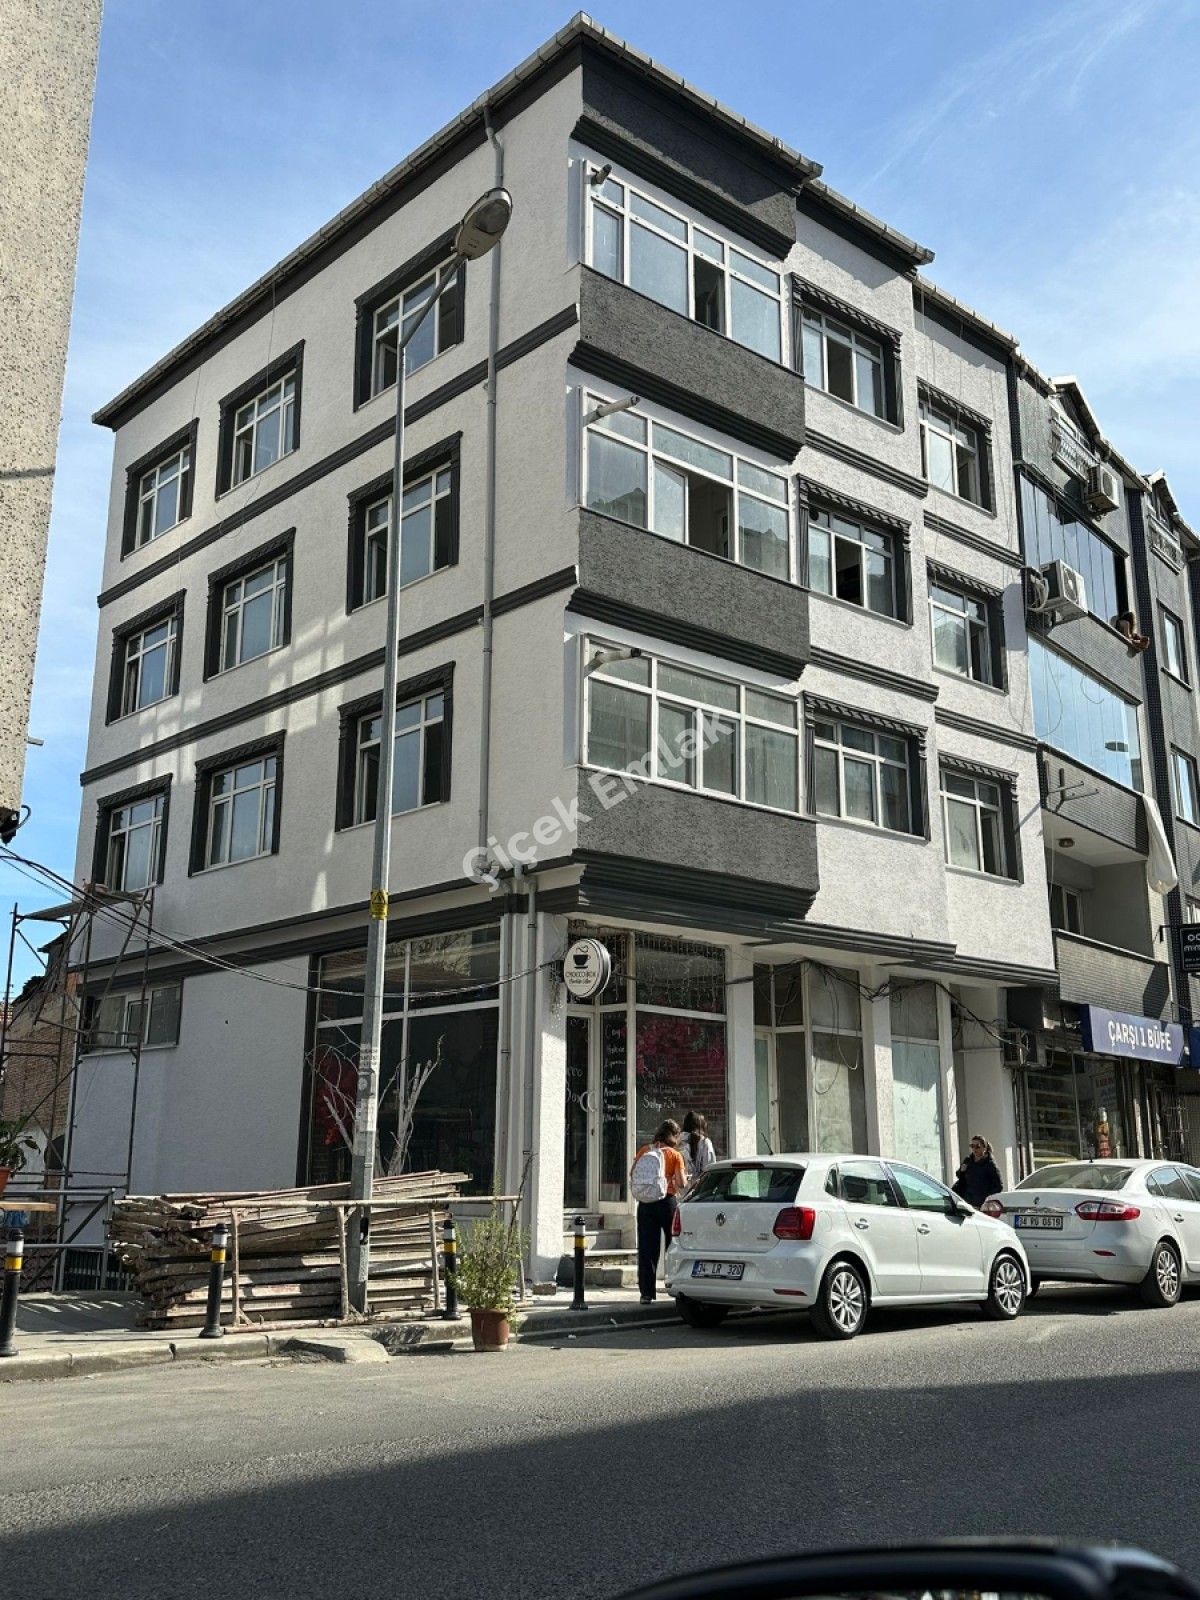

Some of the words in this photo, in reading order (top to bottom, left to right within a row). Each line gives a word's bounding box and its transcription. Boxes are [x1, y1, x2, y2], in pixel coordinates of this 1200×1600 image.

[1108, 1020, 1139, 1050] ÇARŞI
[1140, 1028, 1147, 1048] 1
[1147, 1025, 1173, 1052] BÜFE
[698, 1263, 706, 1273] 34
[711, 1263, 722, 1274] LR
